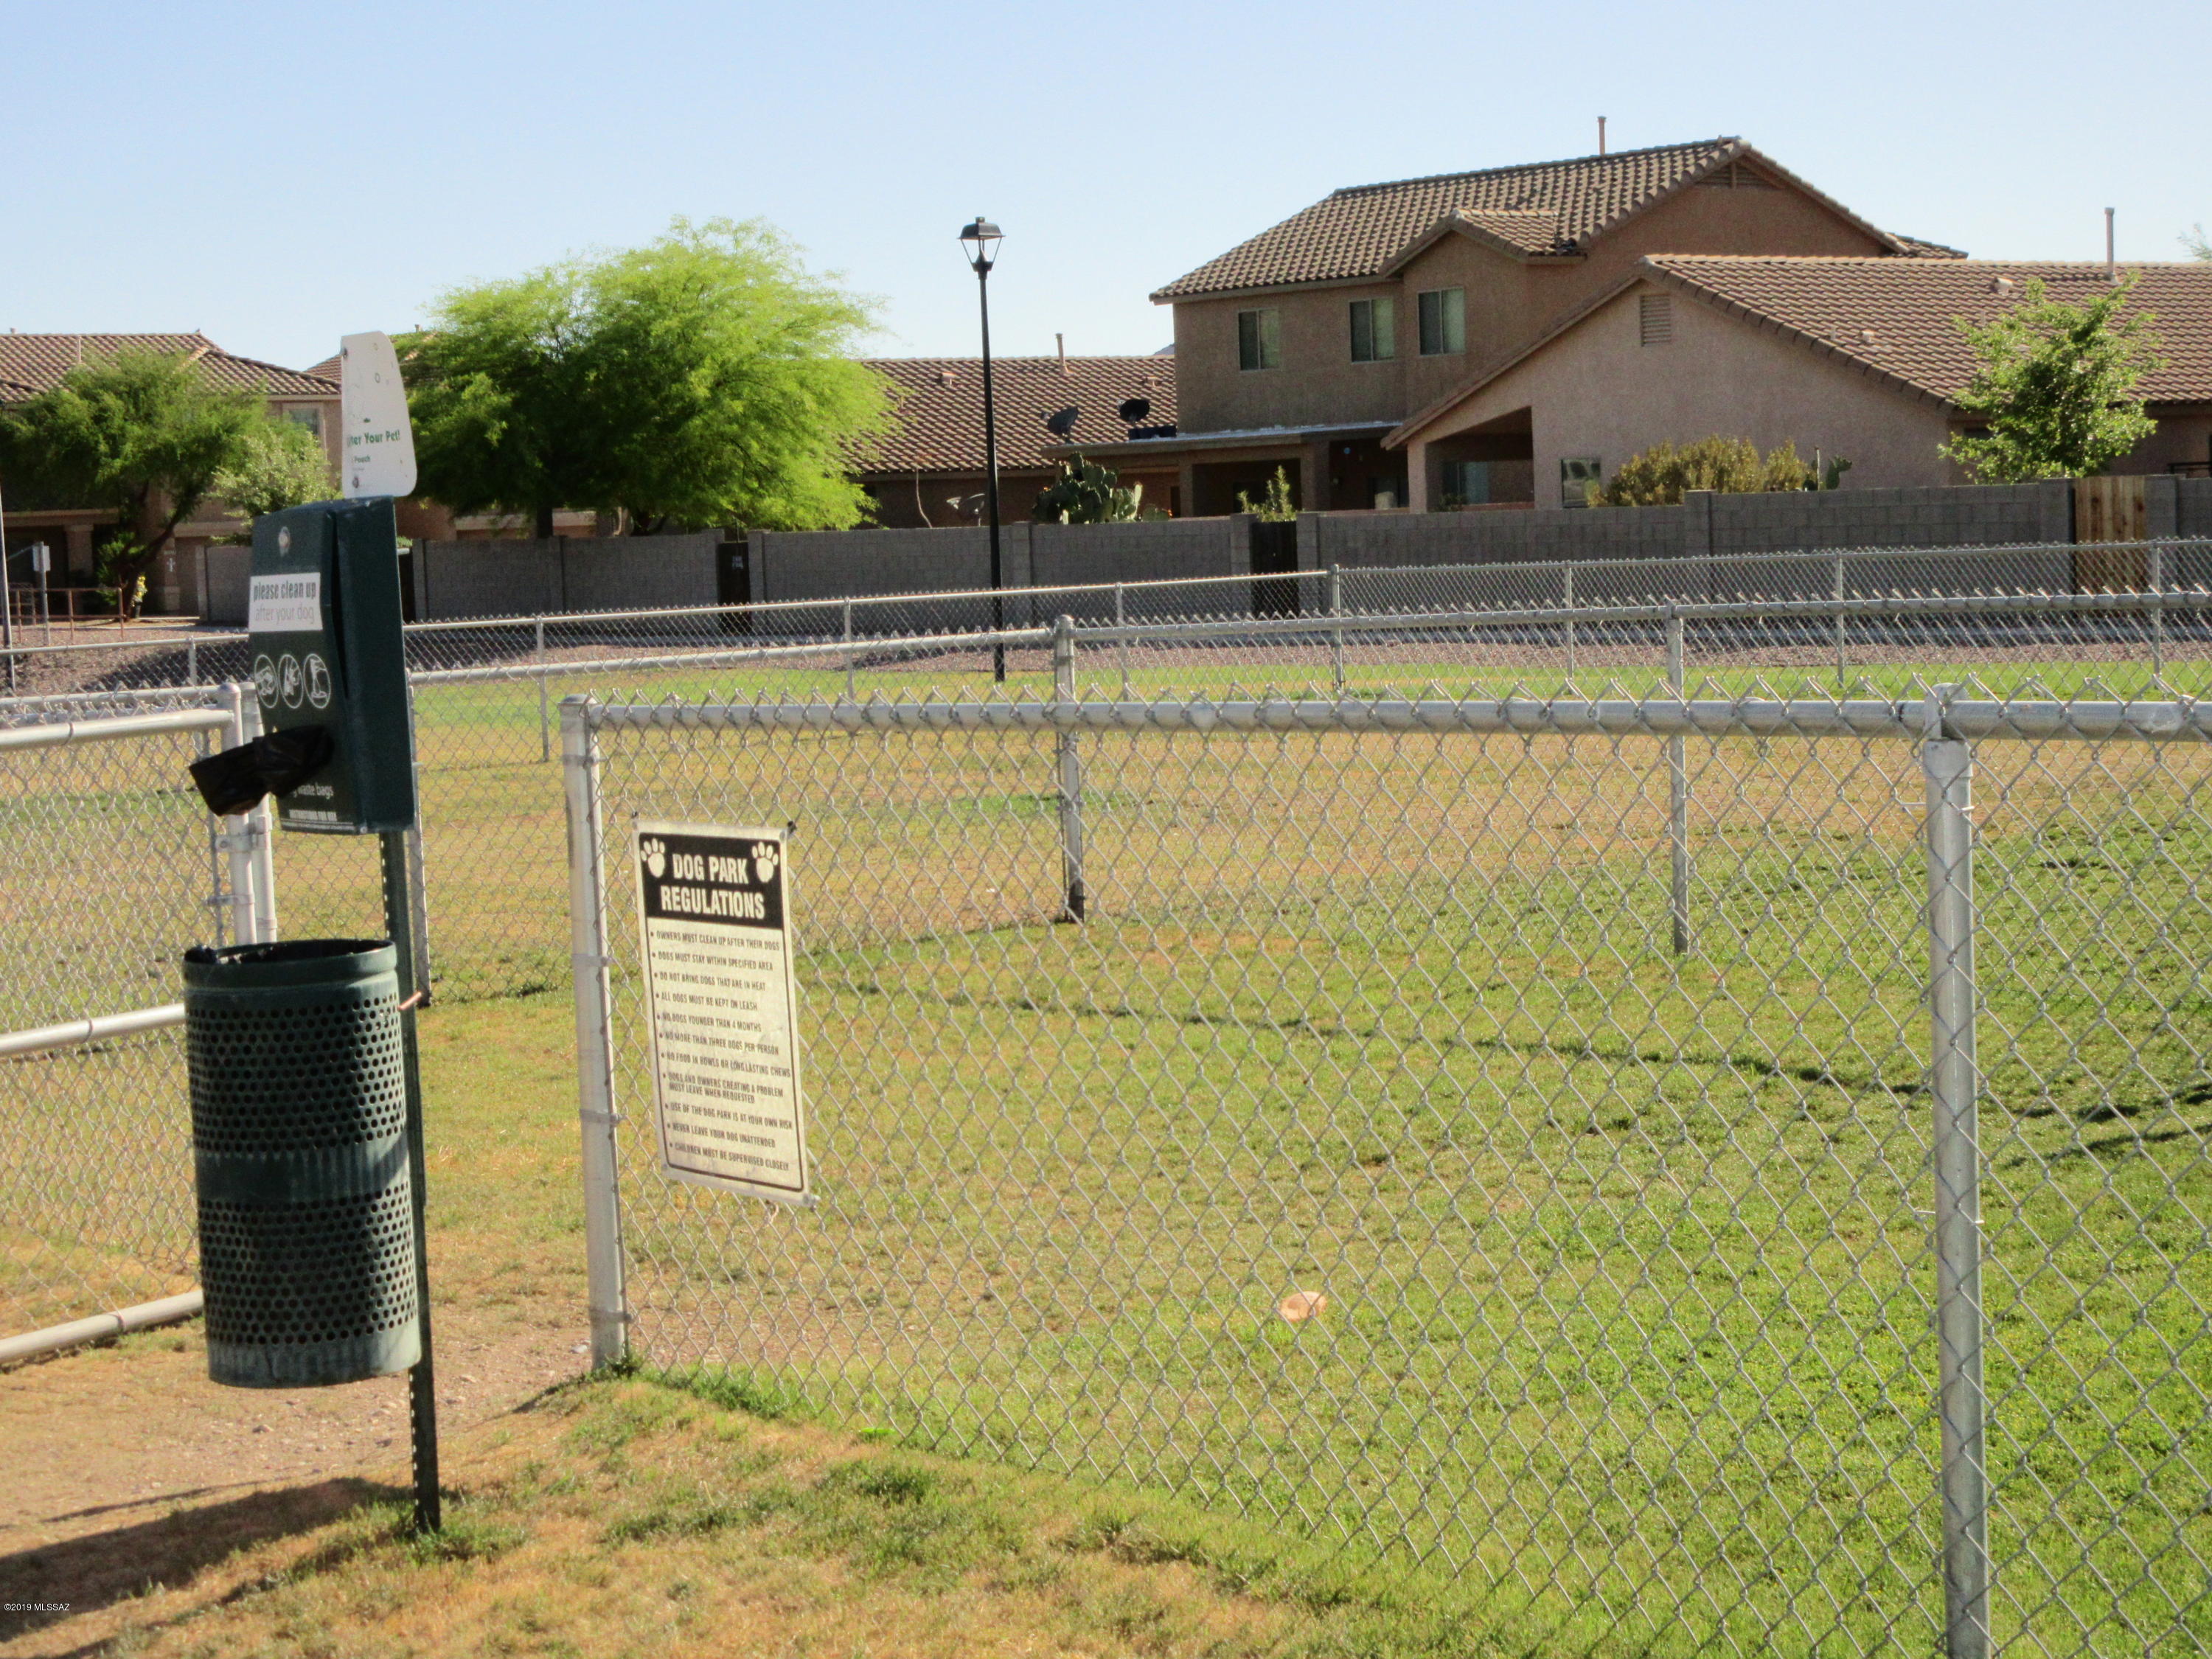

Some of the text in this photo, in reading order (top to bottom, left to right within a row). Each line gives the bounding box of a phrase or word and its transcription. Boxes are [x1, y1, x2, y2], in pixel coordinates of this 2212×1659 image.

[364, 432, 383, 444] Your
[386, 430, 400, 442] Pet!
[254, 580, 316, 602] please clean up
[254, 603, 314, 625] after your dog
[315, 782, 334, 799] bags
[672, 853, 749, 884] DOG PARK
[661, 886, 765, 919] REGULATIONS
[656, 931, 780, 950] OWNERS MUST CLEAN UP AFTER THEIR DOGS
[658, 951, 773, 971] DOGS MUST STAY WITHIN SPECIFIED AREA
[661, 972, 765, 991] DO NOT BRING DOGS THAT ARE IN HEAT
[661, 992, 757, 1010] ALL DOGS MUST BE KEPT ON LEASH
[662, 1012, 761, 1032] NO DOGS YOUNGER THAN 4 MONTHS
[665, 1031, 779, 1055] NO MORE THAN THREE DOGS PER PERSON
[667, 1051, 790, 1077] NO FOOD IN BOWLS OR LONG LASTING CHEWS
[669, 1072, 783, 1097] DOGS AND OWNERS CREATING A PROBLEM
[669, 1082, 755, 1104] MUST LEAVE WHEN REQUESTED
[671, 1102, 792, 1130] USE OF THE DOG PARK IS AT YOUR OWN RISK
[672, 1122, 776, 1147] NEVER LEAVE YOUR DOG UNATTENDED
[675, 1142, 789, 1171] CHILDREN MUST BE SUPERVISED CLOSELY
